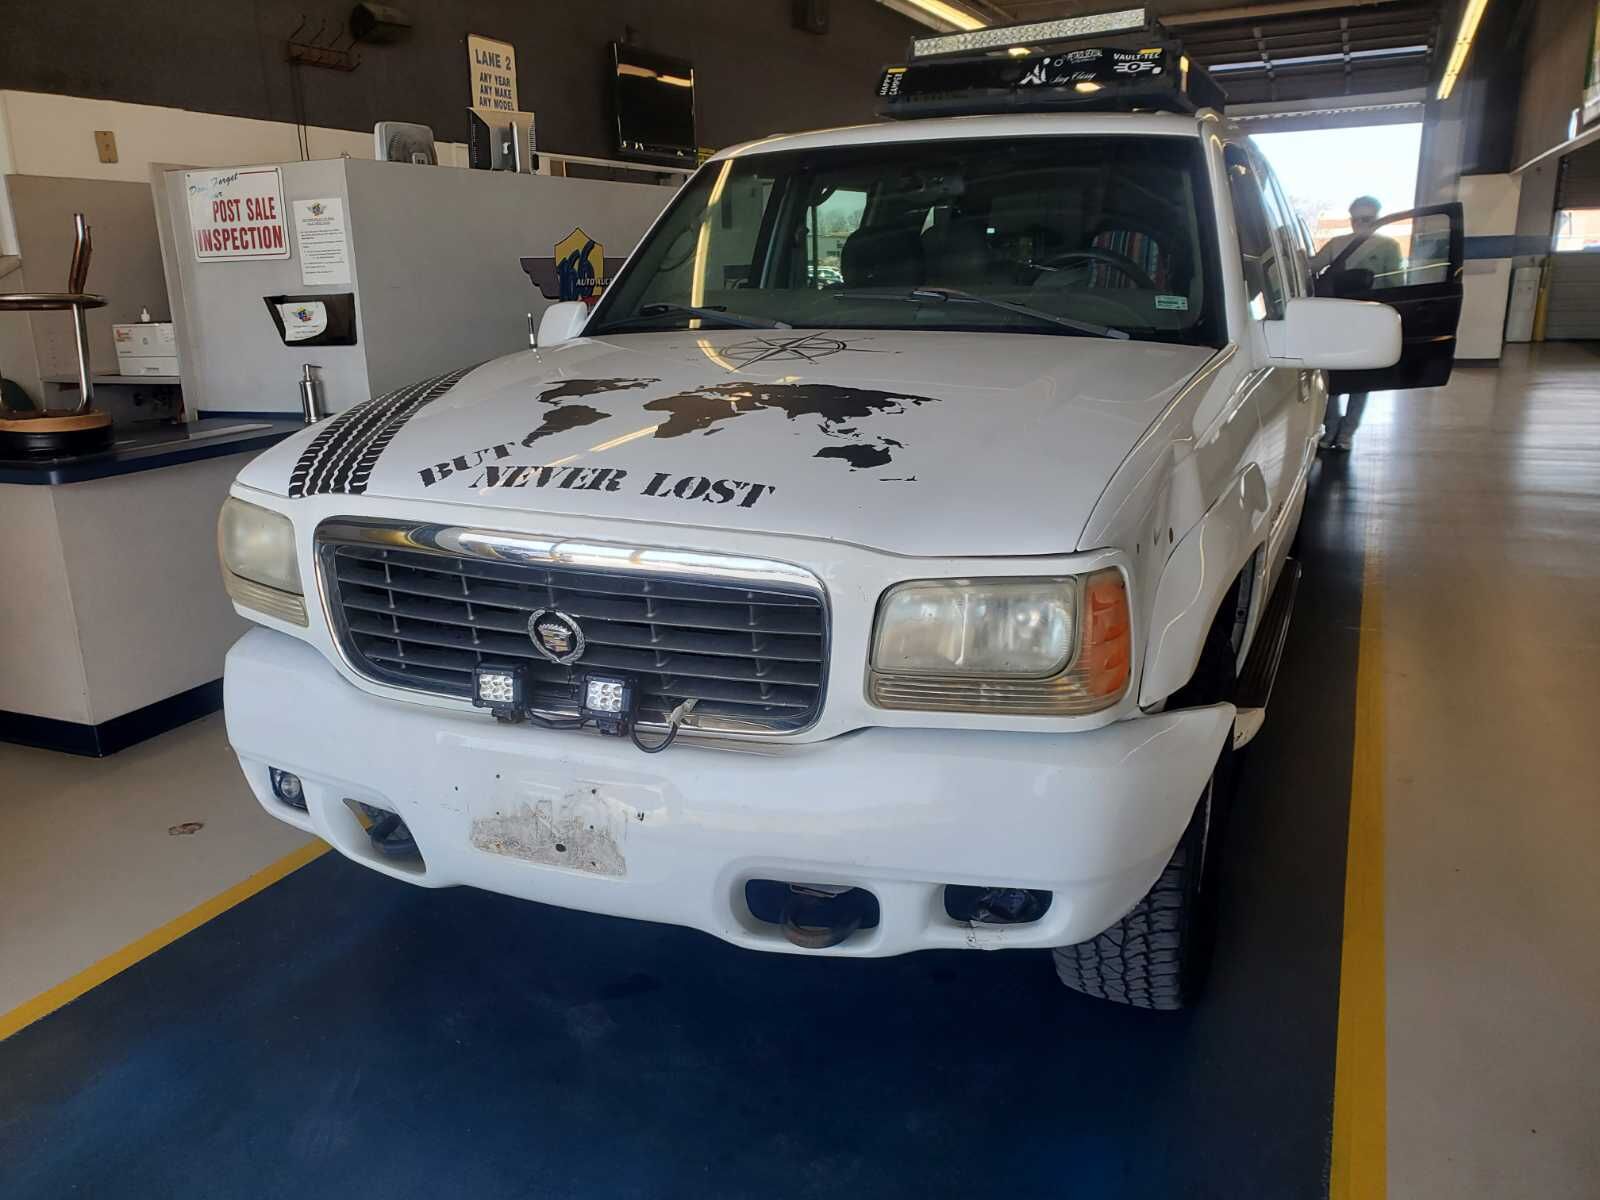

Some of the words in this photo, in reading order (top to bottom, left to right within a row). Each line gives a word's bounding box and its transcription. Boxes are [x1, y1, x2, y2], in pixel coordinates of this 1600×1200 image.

[475, 48, 501, 68] LANE
[505, 56, 512, 71] 2
[480, 72, 492, 83] ANY
[495, 75, 511, 87] YEAR
[480, 84, 492, 96] ANY
[495, 87, 512, 100] MAKE
[480, 96, 492, 107] ANY
[494, 98, 514, 111] MODEL
[211, 198, 241, 223] POST
[246, 197, 277, 221] SALE
[198, 225, 283, 252] INSPECTION
[576, 278, 595, 286] AUTO
[417, 441, 516, 488] BUT
[467, 465, 628, 492] NEVER
[639, 471, 776, 508] LOST
